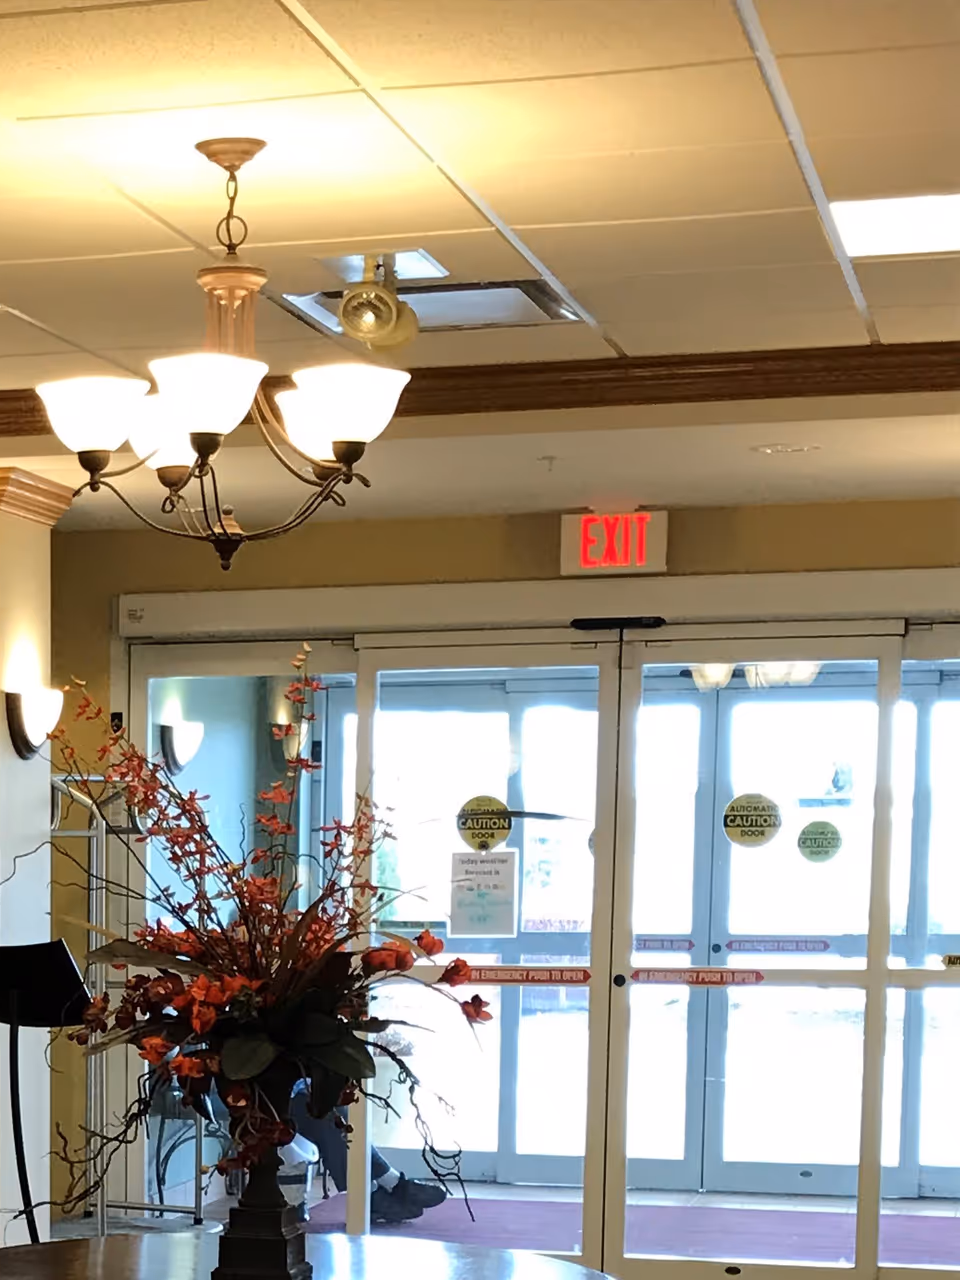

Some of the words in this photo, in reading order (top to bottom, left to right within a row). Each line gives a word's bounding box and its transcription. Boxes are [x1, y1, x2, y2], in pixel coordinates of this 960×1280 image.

[580, 513, 651, 568] EXIT
[729, 805, 779, 813] AUTOMATIC
[459, 818, 509, 829] CAUTION
[726, 816, 781, 827] CAUTION
[471, 831, 496, 839] DOOR
[740, 829, 765, 838] DOOR
[800, 838, 839, 848] CAUTION
[481, 970, 527, 980] EMERGENCY
[529, 970, 550, 980] PUSH
[552, 970, 561, 980] TO
[563, 970, 584, 980] OPEN
[639, 971, 648, 981] IN
[649, 971, 697, 981] EMERGENCY
[699, 971, 721, 981] PUSH
[723, 971, 733, 981] TO
[734, 971, 756, 982] OPEN
